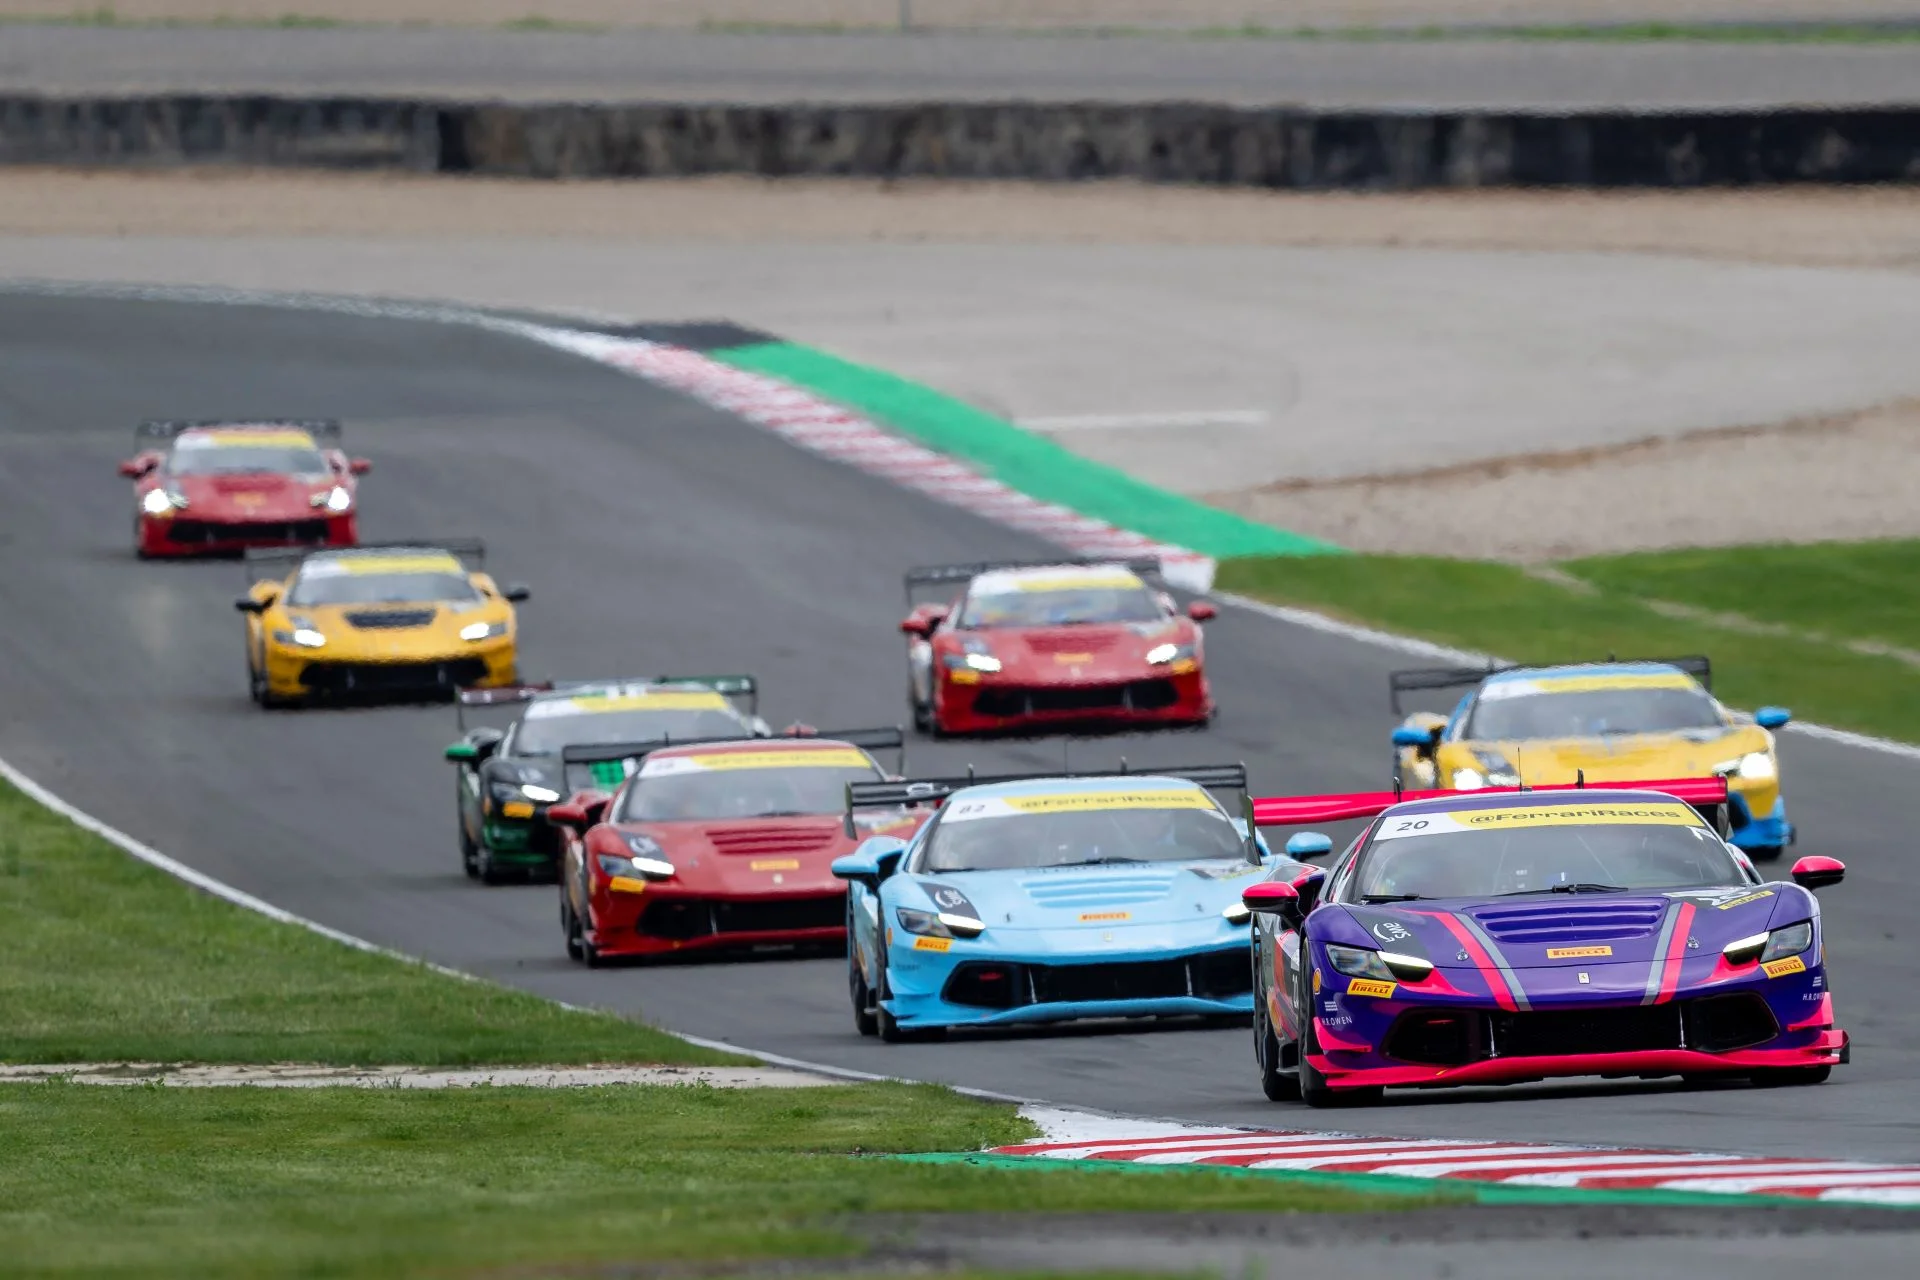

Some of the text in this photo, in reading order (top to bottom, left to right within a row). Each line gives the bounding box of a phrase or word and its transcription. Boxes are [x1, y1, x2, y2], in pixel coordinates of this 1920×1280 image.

[1396, 808, 1682, 832] 20 @FerrariRaces
[1382, 922, 1412, 940] aws
[1552, 946, 1607, 957] PIRELLI
[1766, 959, 1802, 975] PIRELLI
[1350, 981, 1392, 994] PIRELLI
